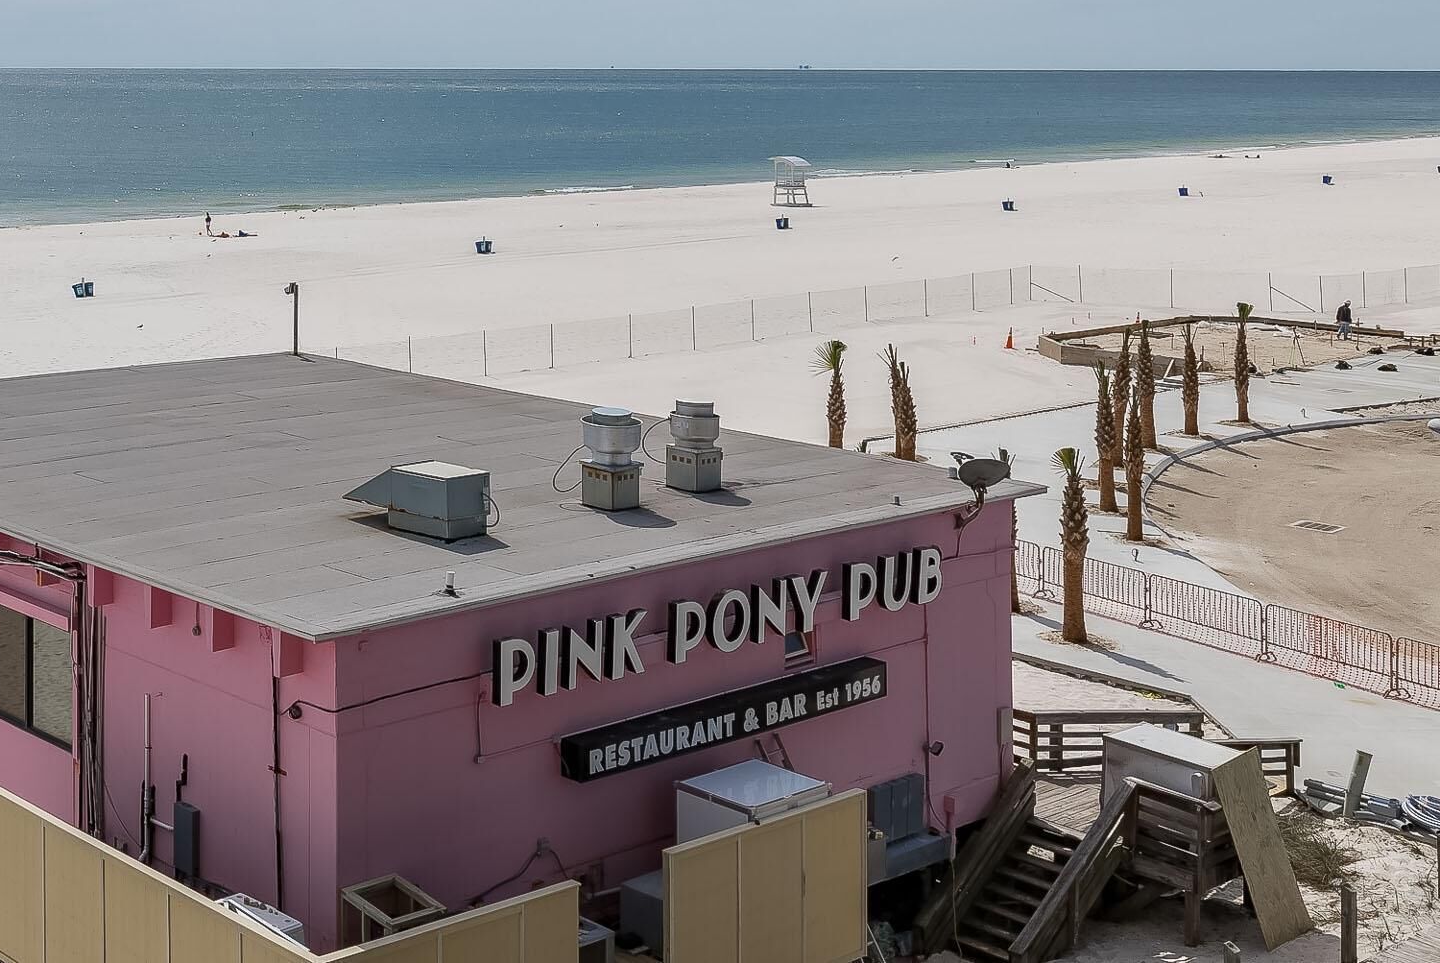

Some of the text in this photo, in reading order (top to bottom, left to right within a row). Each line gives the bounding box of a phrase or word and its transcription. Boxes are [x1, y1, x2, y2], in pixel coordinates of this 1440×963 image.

[493, 545, 943, 707] PINK PONY PUB
[589, 674, 881, 775] RESTAURANT & BAR Est 1956
